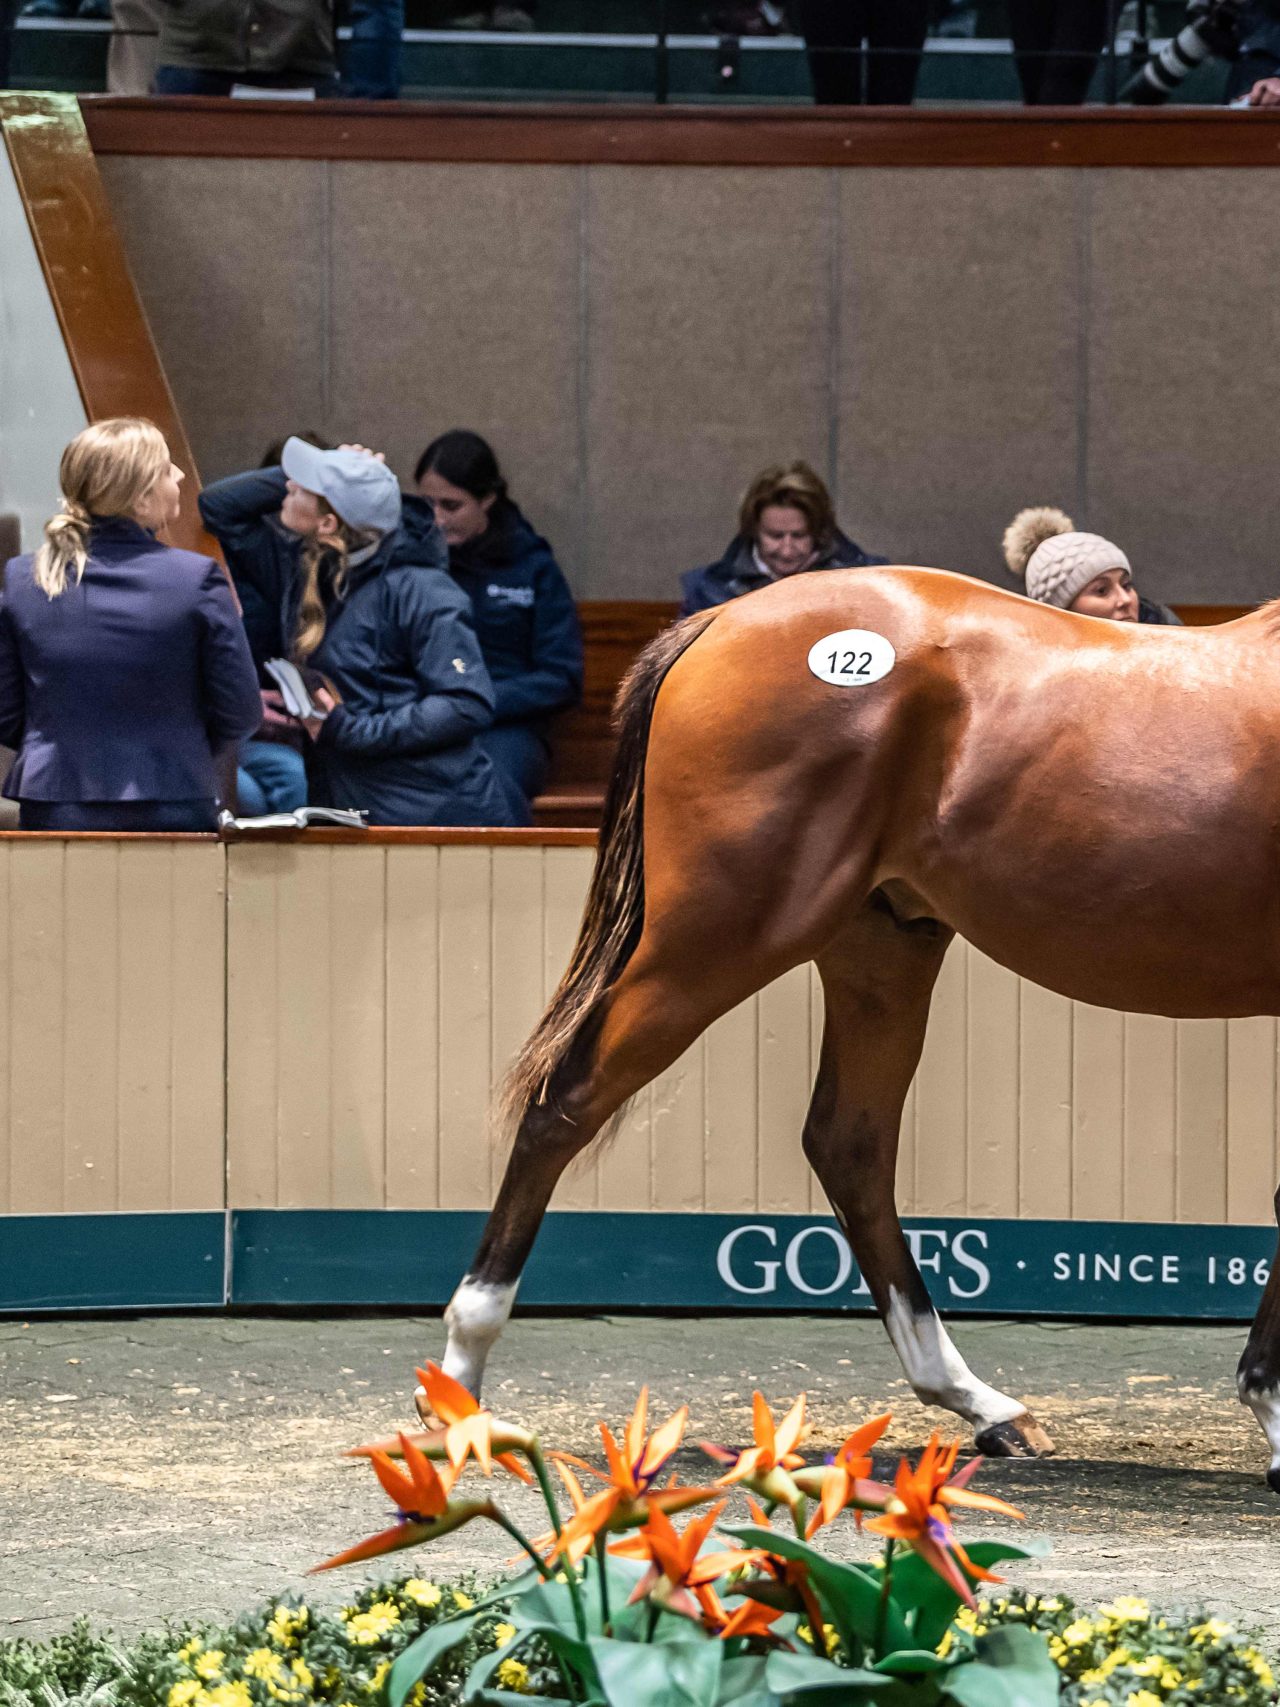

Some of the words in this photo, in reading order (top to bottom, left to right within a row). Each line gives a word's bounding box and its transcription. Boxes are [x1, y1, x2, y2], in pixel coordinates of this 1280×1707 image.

[827, 651, 873, 675] 122
[716, 1224, 991, 1299] GOFS
[1053, 1252, 1180, 1283] SINCE
[1208, 1256, 1271, 1286] 186
